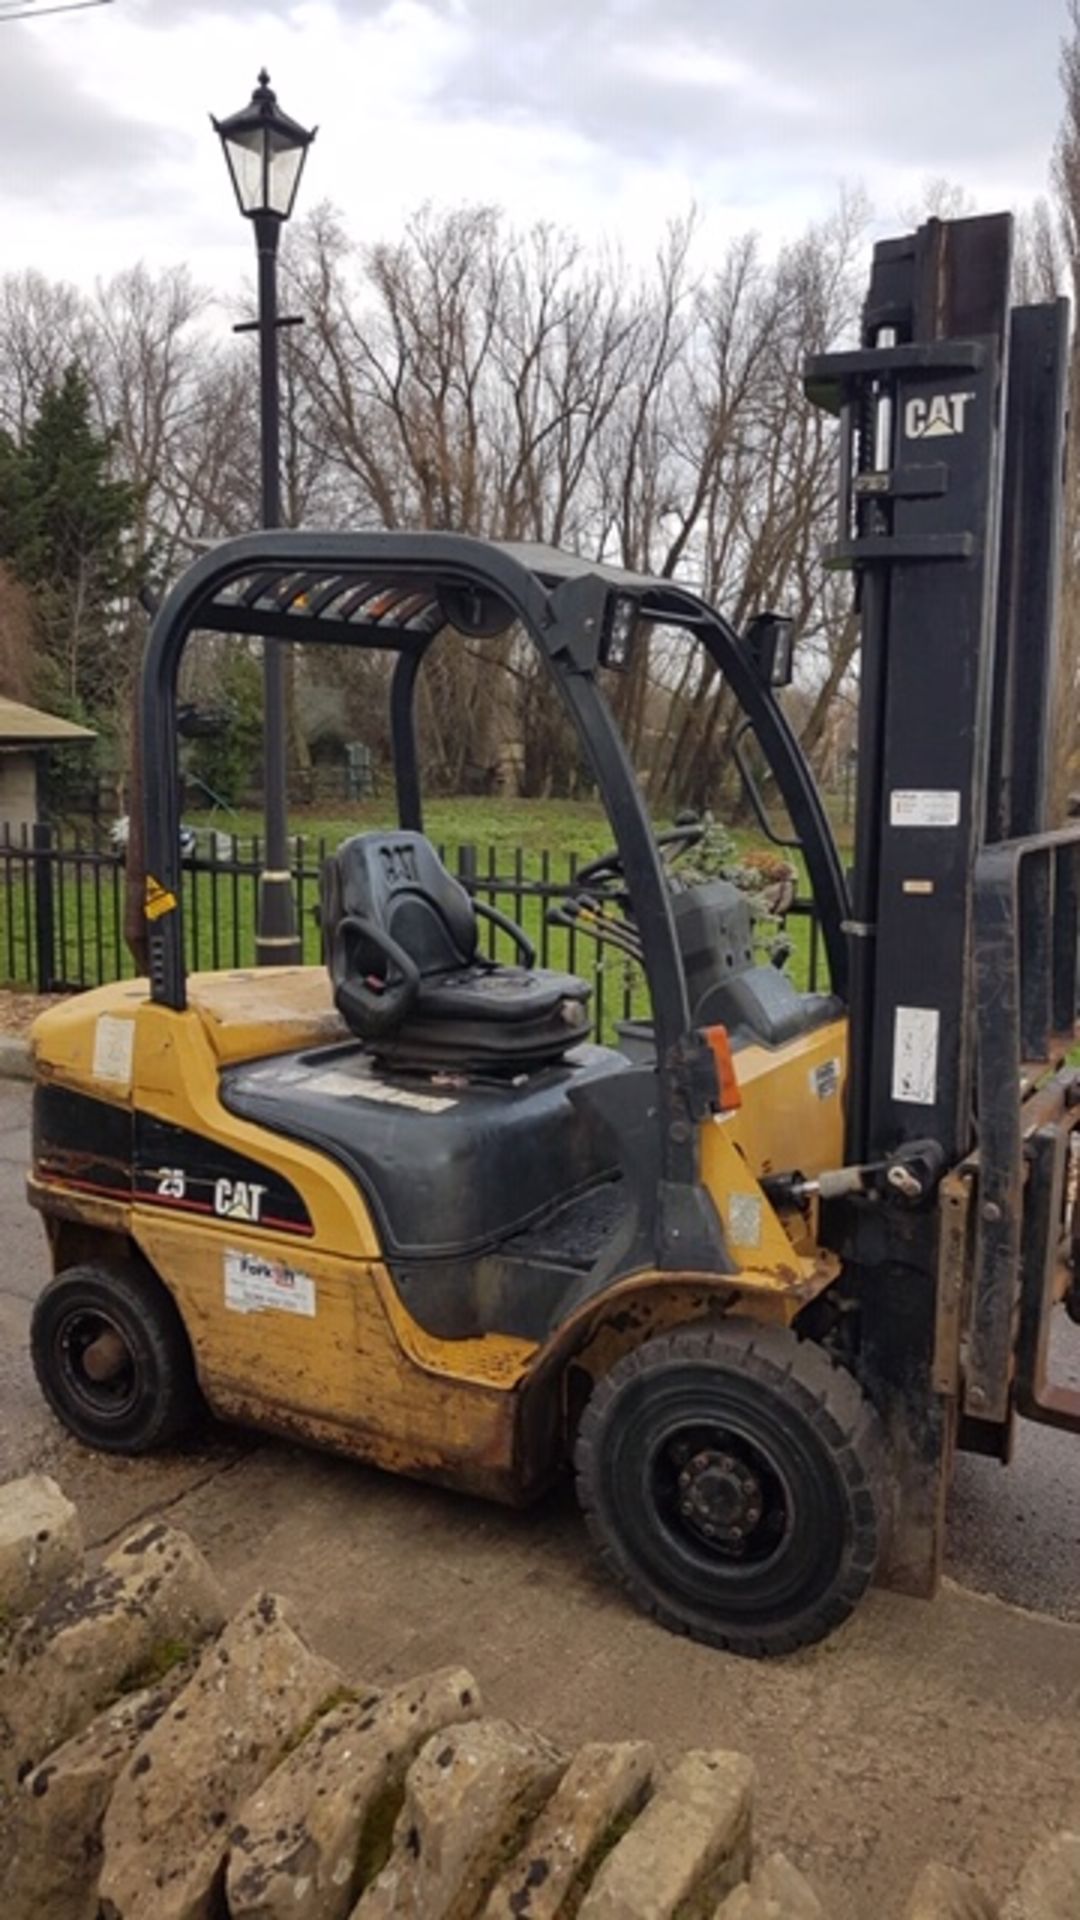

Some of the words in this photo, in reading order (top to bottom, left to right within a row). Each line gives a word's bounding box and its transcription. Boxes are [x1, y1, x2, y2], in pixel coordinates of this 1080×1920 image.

[904, 392, 970, 439] CAT
[378, 844, 419, 884] CAT
[157, 1167, 186, 1199] 25
[214, 1178, 264, 1221] CAT
